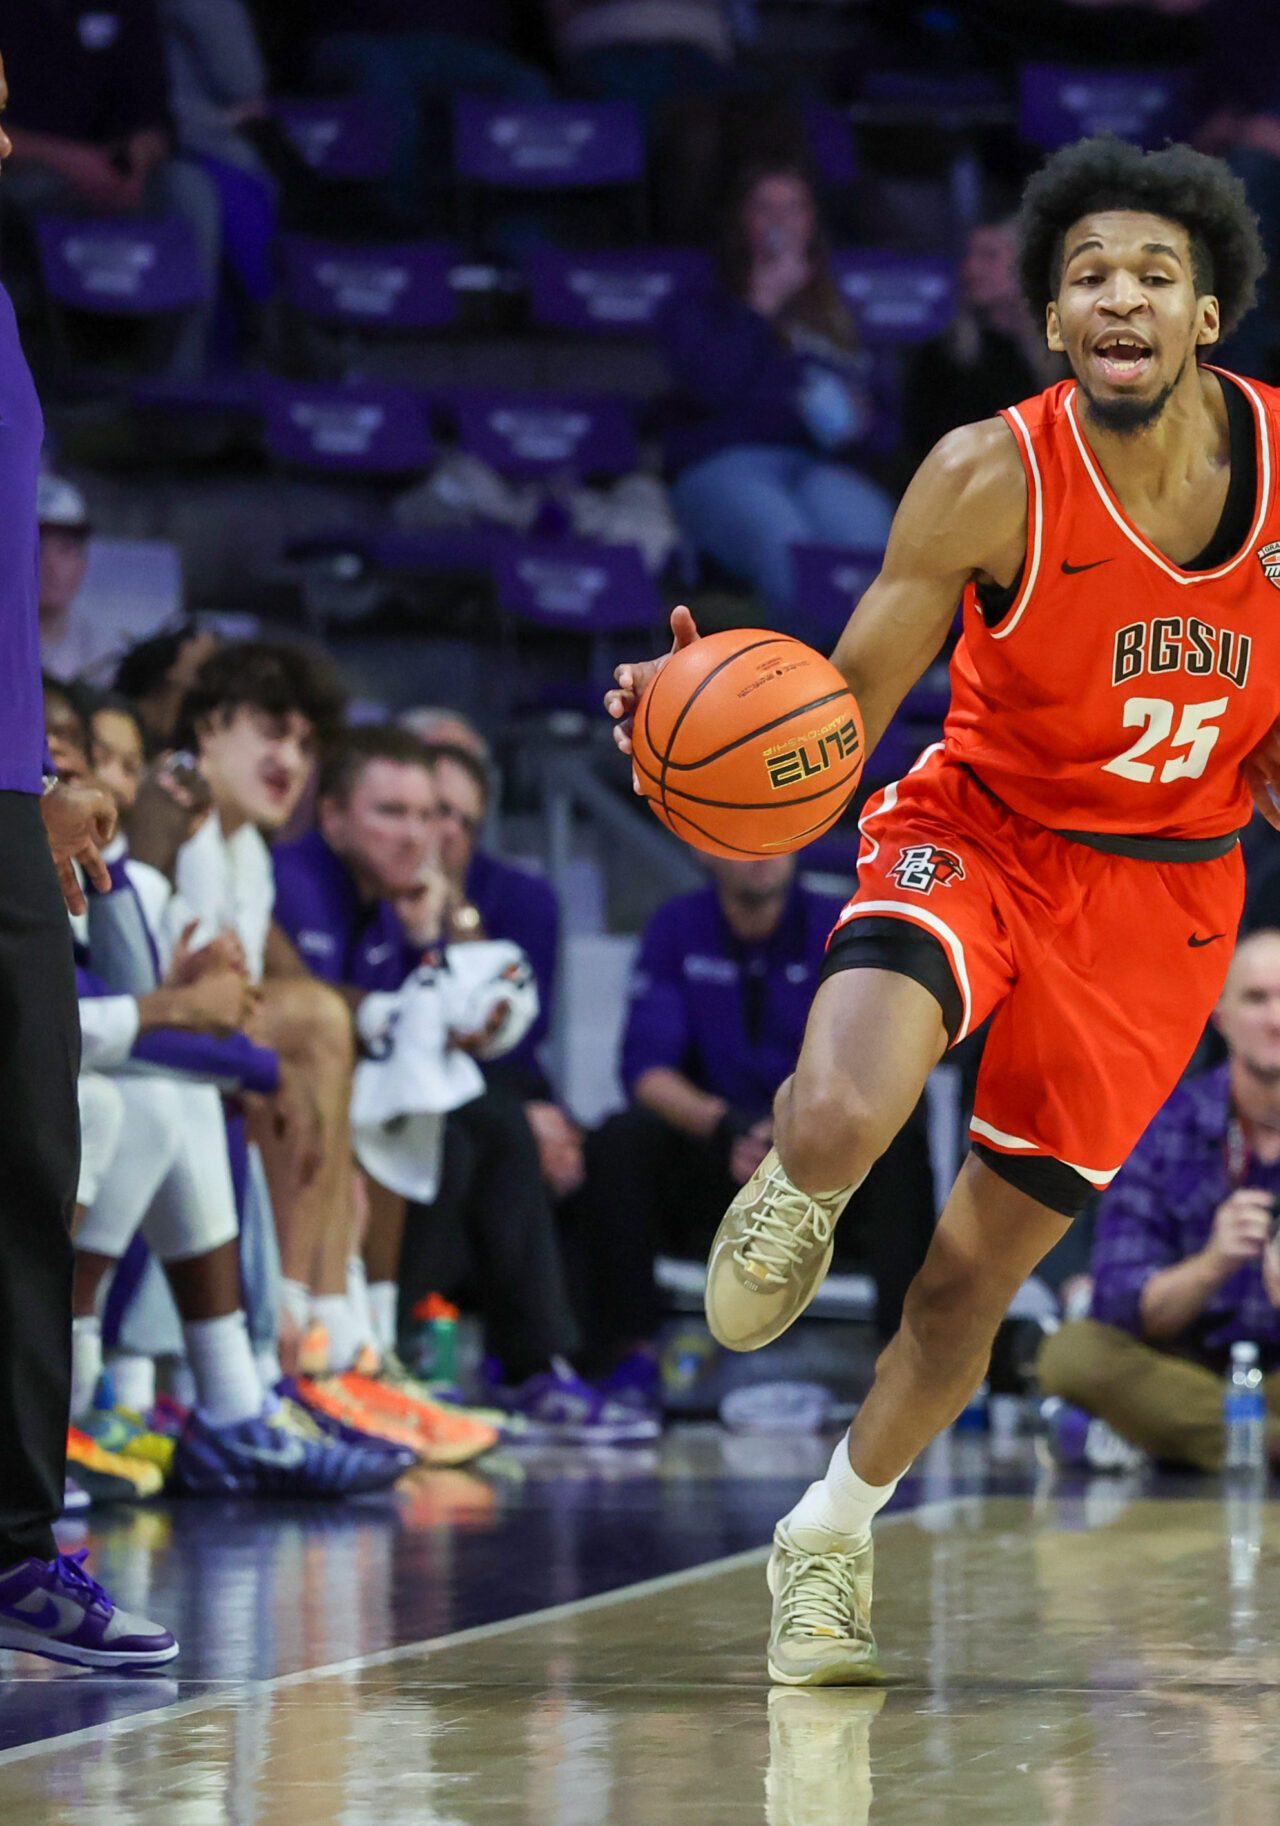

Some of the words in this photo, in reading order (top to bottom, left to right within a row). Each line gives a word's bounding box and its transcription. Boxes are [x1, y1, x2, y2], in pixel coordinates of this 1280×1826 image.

[1112, 616, 1252, 689] BGSU
[764, 718, 860, 790] ELITE
[1101, 696, 1229, 784] 25
